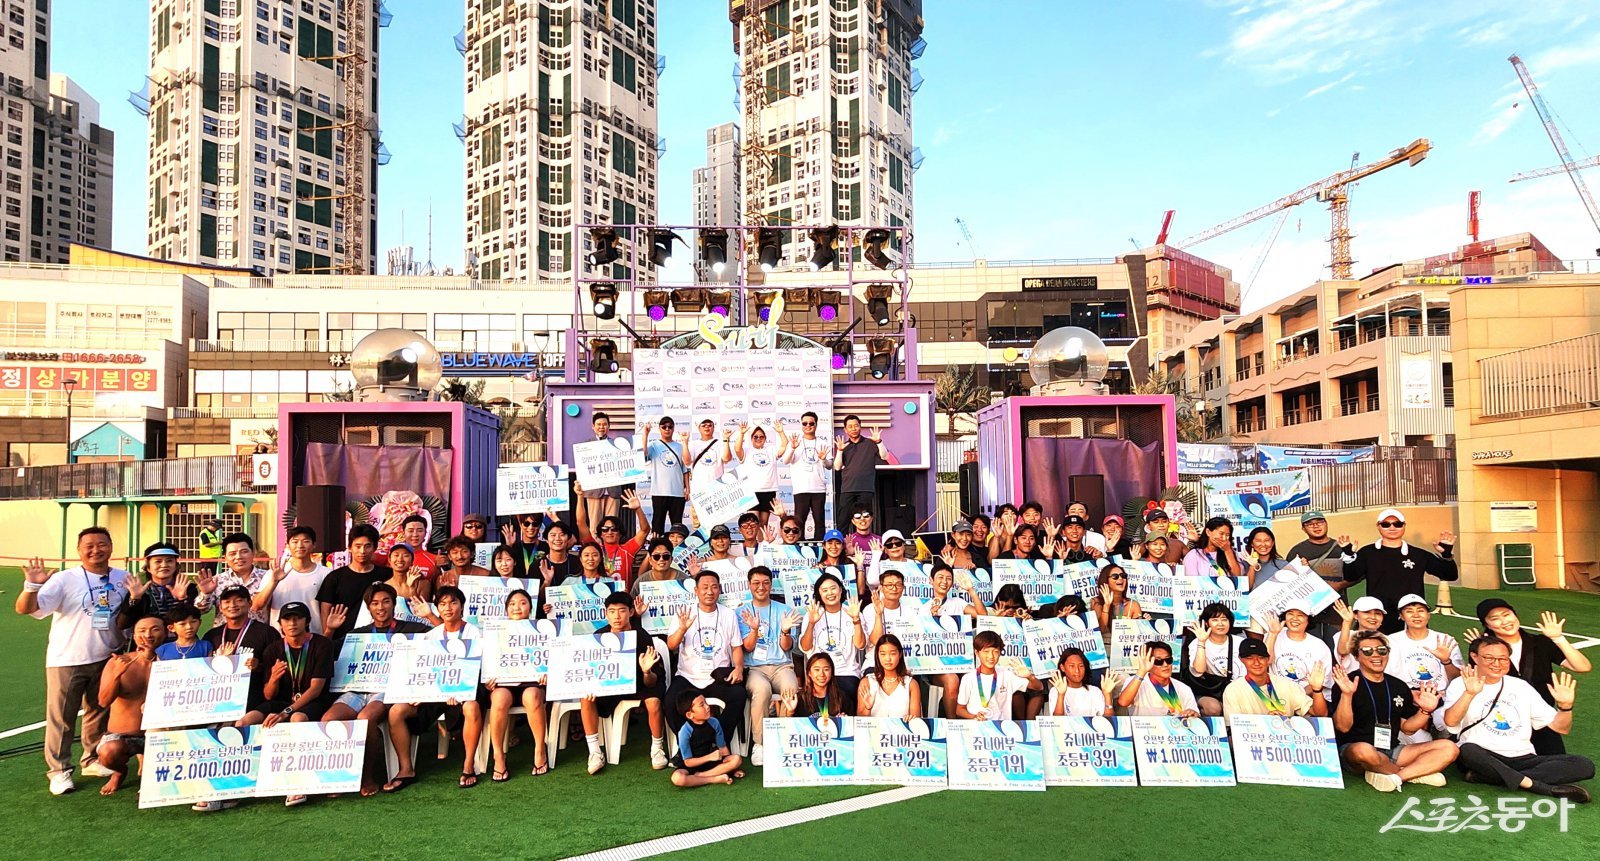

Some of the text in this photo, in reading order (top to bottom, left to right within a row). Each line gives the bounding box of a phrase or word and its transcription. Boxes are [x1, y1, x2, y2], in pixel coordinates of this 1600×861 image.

[508, 479, 557, 490] BEST STYLE
[469, 593, 493, 604] BEST
[416, 654, 457, 668] 쥬니어부
[500, 654, 530, 667] 중등부
[572, 648, 613, 661] 쥬니어부
[406, 668, 461, 686] 고등부 1위
[564, 663, 620, 684] 중등부 2위
[789, 733, 830, 748] 쥬니어부
[880, 733, 921, 748] 쥬니어부
[972, 736, 1016, 750] 쥬니어부
[1064, 732, 1107, 747] 쥬니어부
[1143, 735, 1165, 745] 오픈부
[1167, 735, 1188, 744] 숏보드
[1242, 732, 1264, 743] 오픈부
[1268, 734, 1289, 744] 숏보드
[156, 751, 184, 762] 오픈부
[187, 748, 214, 760] 숏보드
[782, 750, 837, 768] 초등부 1위
[871, 750, 930, 768] 초등부 2위
[1057, 749, 1118, 768] 초등부 3위
[967, 755, 1025, 773] 중등부 1위
